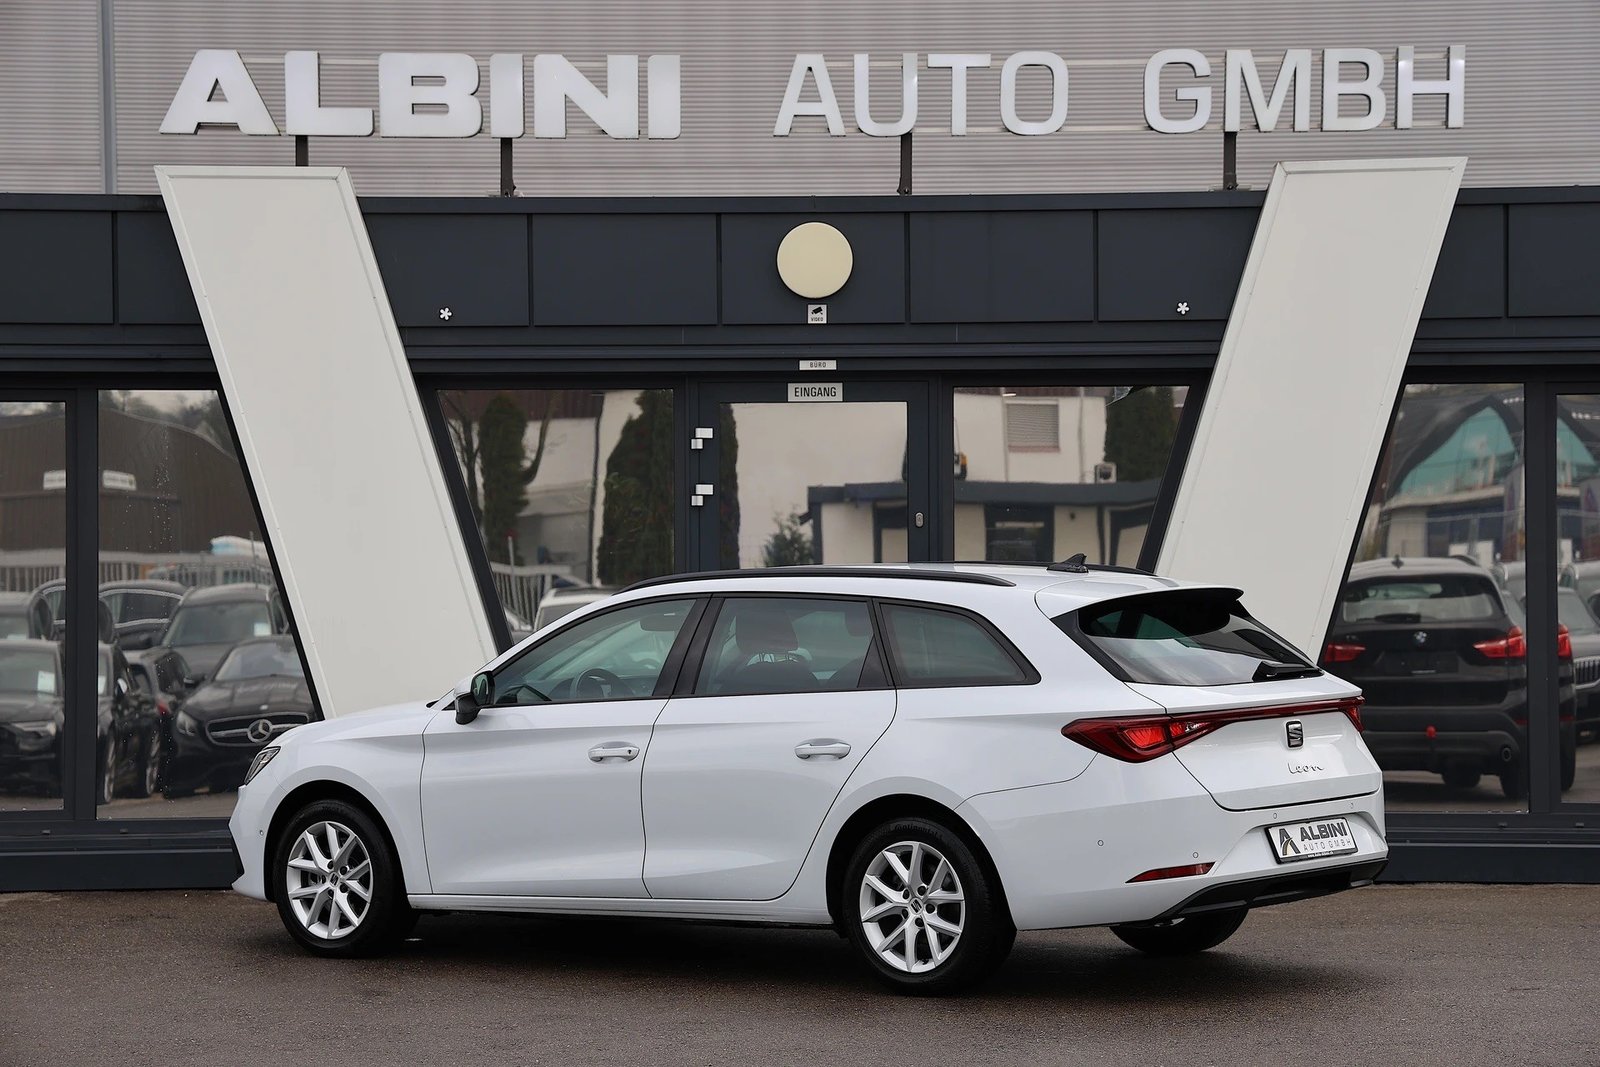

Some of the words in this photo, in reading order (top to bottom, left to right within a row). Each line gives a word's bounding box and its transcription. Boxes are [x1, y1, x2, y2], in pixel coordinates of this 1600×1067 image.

[158, 49, 682, 139] ALBINI
[773, 51, 1069, 137] AUTO
[1143, 45, 1466, 134] GMBH
[794, 387, 837, 397] EINGANG
[1288, 762, 1325, 774] Leon
[1300, 822, 1348, 841] ALBINI
[1303, 841, 1327, 851] AUTO
[1328, 838, 1352, 848] GMBH
